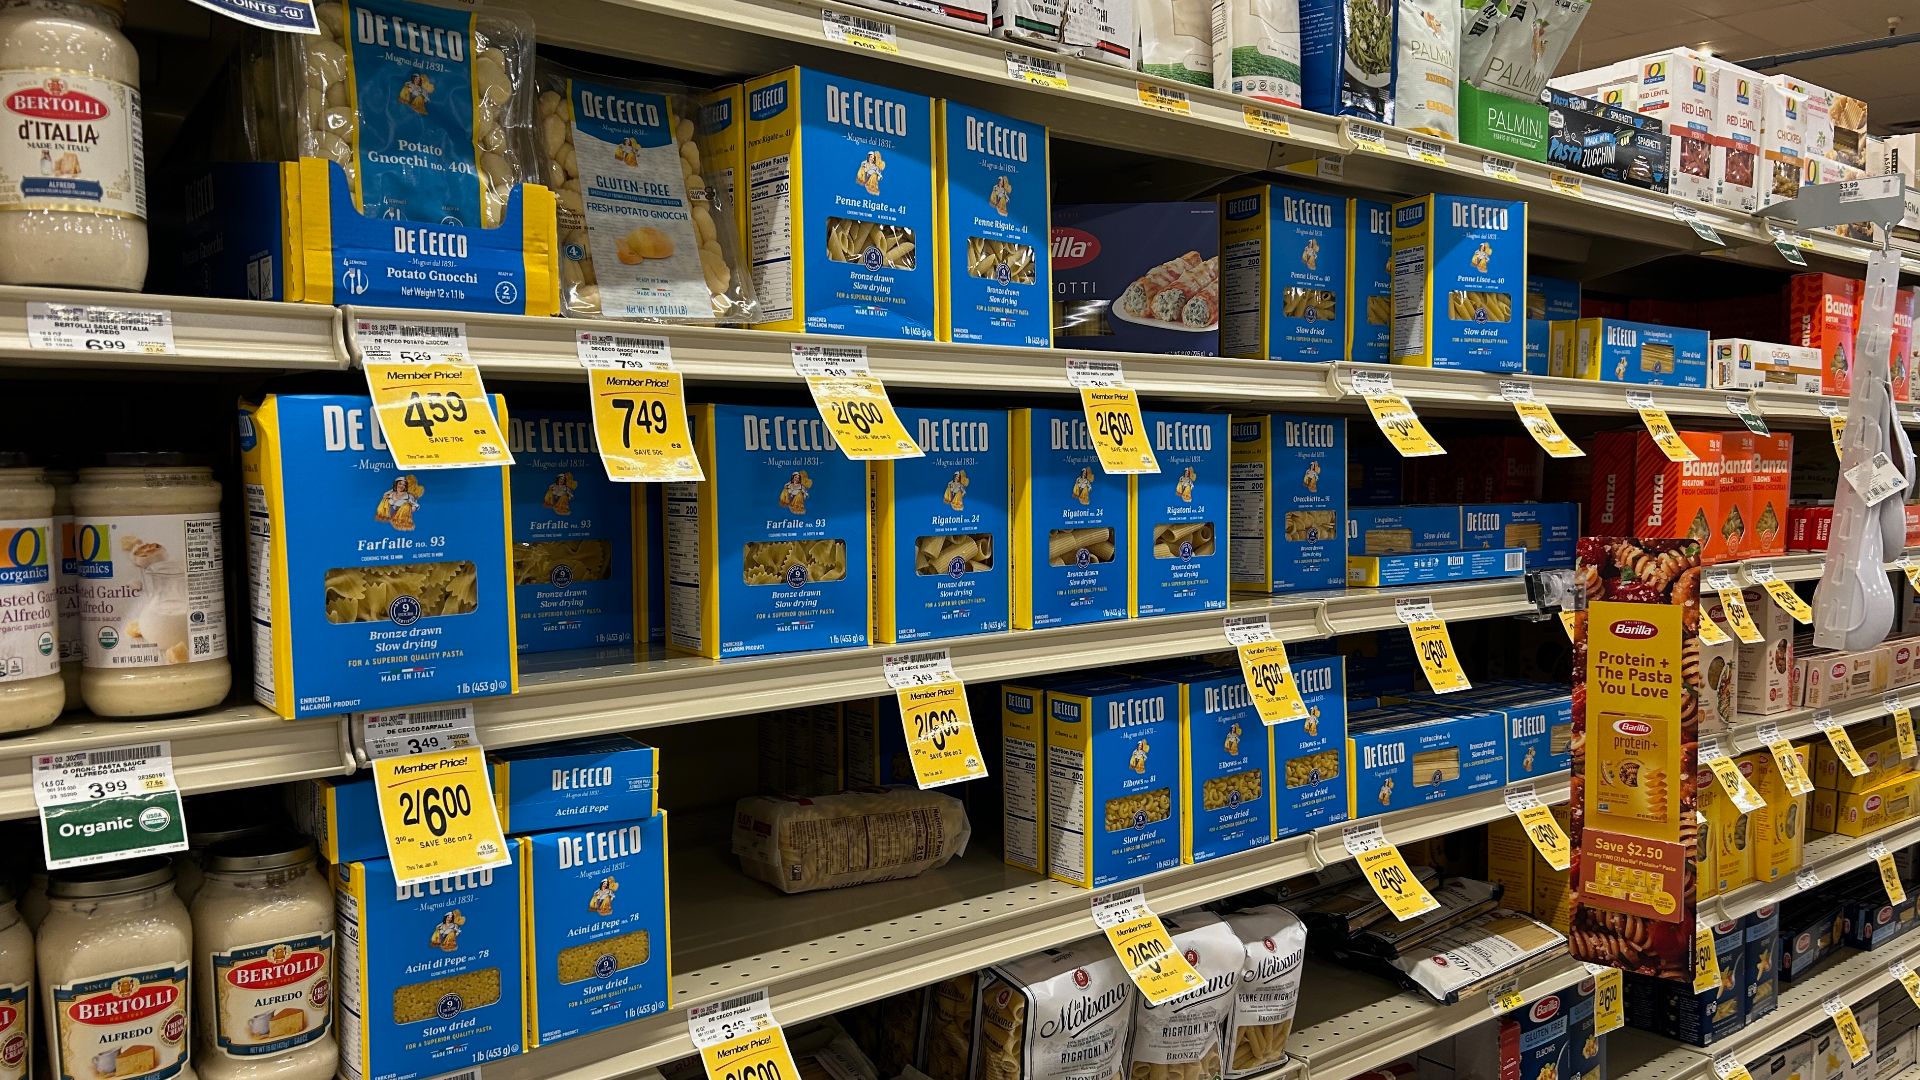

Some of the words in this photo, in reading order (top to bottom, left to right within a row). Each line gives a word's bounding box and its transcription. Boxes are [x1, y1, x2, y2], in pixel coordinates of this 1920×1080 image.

[356, 7, 389, 47] DE
[392, 16, 464, 62] CECCO
[14, 95, 100, 115] BERTOLLI
[582, 90, 606, 119] DE
[606, 91, 659, 126] CECCO
[752, 93, 761, 112] DE
[763, 86, 783, 108] CECCO
[826, 85, 850, 125] DE
[854, 91, 906, 137] CECCO
[1682, 102, 1694, 114] RED
[1696, 107, 1712, 120] LENTIL
[19, 119, 99, 144] d'ITALIA
[1488, 108, 1541, 139] PALMINI
[1727, 115, 1738, 126] RED
[1739, 117, 1756, 132] LENTIL
[398, 139, 442, 156] Potato
[967, 116, 984, 153] DE
[987, 121, 1027, 163] CECCO
[368, 151, 428, 168] Gnocchi
[1548, 137, 1582, 165] PASTA
[1582, 146, 1616, 168] ZUCCHINI
[48, 181, 76, 190] ALFREDO
[596, 176, 670, 196] GLUTEN-FREE
[1839, 181, 1858, 190] $3.99
[587, 202, 613, 213] FRESH
[615, 205, 649, 217] POTATO
[651, 209, 688, 221] GNOCCHI
[836, 195, 861, 208] Penne
[863, 199, 889, 212] Rigate
[1283, 197, 1298, 222] DE
[1299, 200, 1332, 227] CECCO
[1452, 203, 1469, 228] DE
[1471, 204, 1508, 230] CECCO
[395, 227, 415, 254] DE
[419, 229, 468, 258] CECCO
[387, 267, 426, 279] Potato
[429, 269, 477, 283] Gnocchi
[1825, 294, 1853, 317] Banza
[387, 371, 432, 380] Member
[434, 371, 462, 379] Price!
[607, 377, 644, 387] Member
[645, 379, 669, 388] Price!
[918, 418, 940, 452] DE
[942, 419, 989, 452] CECCO
[1157, 421, 1173, 451] DE
[1175, 422, 1211, 451] CECCO
[1285, 421, 1300, 447] DE
[1302, 422, 1334, 447] CECCO
[1752, 454, 1788, 473] Banza
[1601, 474, 1616, 523] Banza
[1647, 474, 1665, 526] Banza
[1467, 513, 1477, 532] DE
[1478, 512, 1500, 531] CECCO
[358, 537, 413, 551] Farfalle
[430, 536, 445, 547] 93
[0, 568, 47, 583] organics
[97, 585, 140, 598] Garlic
[772, 591, 798, 599] Bronze
[793, 600, 817, 608] drying
[2, 609, 50, 624] Alfredo
[370, 630, 408, 641] Bronze
[409, 627, 442, 636] drawn
[1615, 624, 1652, 636] Barilla
[375, 643, 401, 652] Slow
[402, 639, 438, 650] drying
[373, 655, 408, 665] SUPERIOR
[411, 653, 441, 662] QUALITY
[1599, 651, 1655, 668] Protein
[381, 674, 401, 682] MADE
[414, 671, 434, 679] ITALY
[1301, 667, 1331, 694] CECCO
[1595, 666, 1624, 681] The
[1629, 668, 1673, 684] Pasta
[910, 691, 936, 700] Member
[937, 688, 954, 697] Price!
[1598, 681, 1625, 695] You
[1631, 683, 1669, 699] Love
[1205, 687, 1220, 714] DE
[1109, 701, 1125, 730] DE
[1128, 697, 1164, 726] CECCO
[1622, 722, 1650, 733] Barilla
[1364, 746, 1376, 770] DE
[1377, 742, 1405, 767] CECCO
[75, 769, 108, 778] ALFREDO
[110, 766, 135, 774] GARLIC
[394, 761, 438, 775] Member
[440, 757, 468, 769] Price!
[552, 768, 570, 791] DE
[572, 766, 612, 788] CECCO
[555, 806, 578, 817] Acini
[579, 805, 588, 814] di
[589, 804, 608, 814] Pepe
[1219, 812, 1232, 822] Slow
[1233, 809, 1249, 819] dried
[59, 816, 133, 837] Organic
[1123, 836, 1138, 845] Slow
[1139, 830, 1156, 842] dried
[558, 836, 583, 870] DE
[586, 826, 642, 863] CECCO
[1595, 838, 1623, 852] Save
[1627, 842, 1662, 859] $2.50
[567, 924, 590, 938] Acini
[592, 922, 599, 931] di
[600, 918, 620, 931] Pepe
[629, 912, 640, 922] 78
[236, 956, 320, 984] BERTOLLI
[405, 961, 432, 974] Acini
[434, 958, 443, 967] di
[444, 954, 467, 967] Pepe
[479, 950, 490, 959] 78
[583, 984, 604, 996] Slow
[605, 976, 628, 990] dried
[79, 989, 173, 1019] BERTOLLI
[254, 991, 303, 1007] ALFREDO
[1040, 983, 1131, 1038] Molisana
[98, 1026, 153, 1044] ALFREDO
[423, 1026, 448, 1037] Slow
[449, 1018, 476, 1030] dried
[1163, 1024, 1200, 1037] RIGATONI
[1525, 1028, 1549, 1042] GLUTEN
[1551, 1020, 1564, 1032] FREE
[717, 1042, 750, 1059] Member
[751, 1035, 771, 1048] Price!
[1061, 1045, 1101, 1063] RIGATONI
[1166, 1051, 1199, 1060] BRONZE
[1536, 1044, 1555, 1059] ELBOWS
